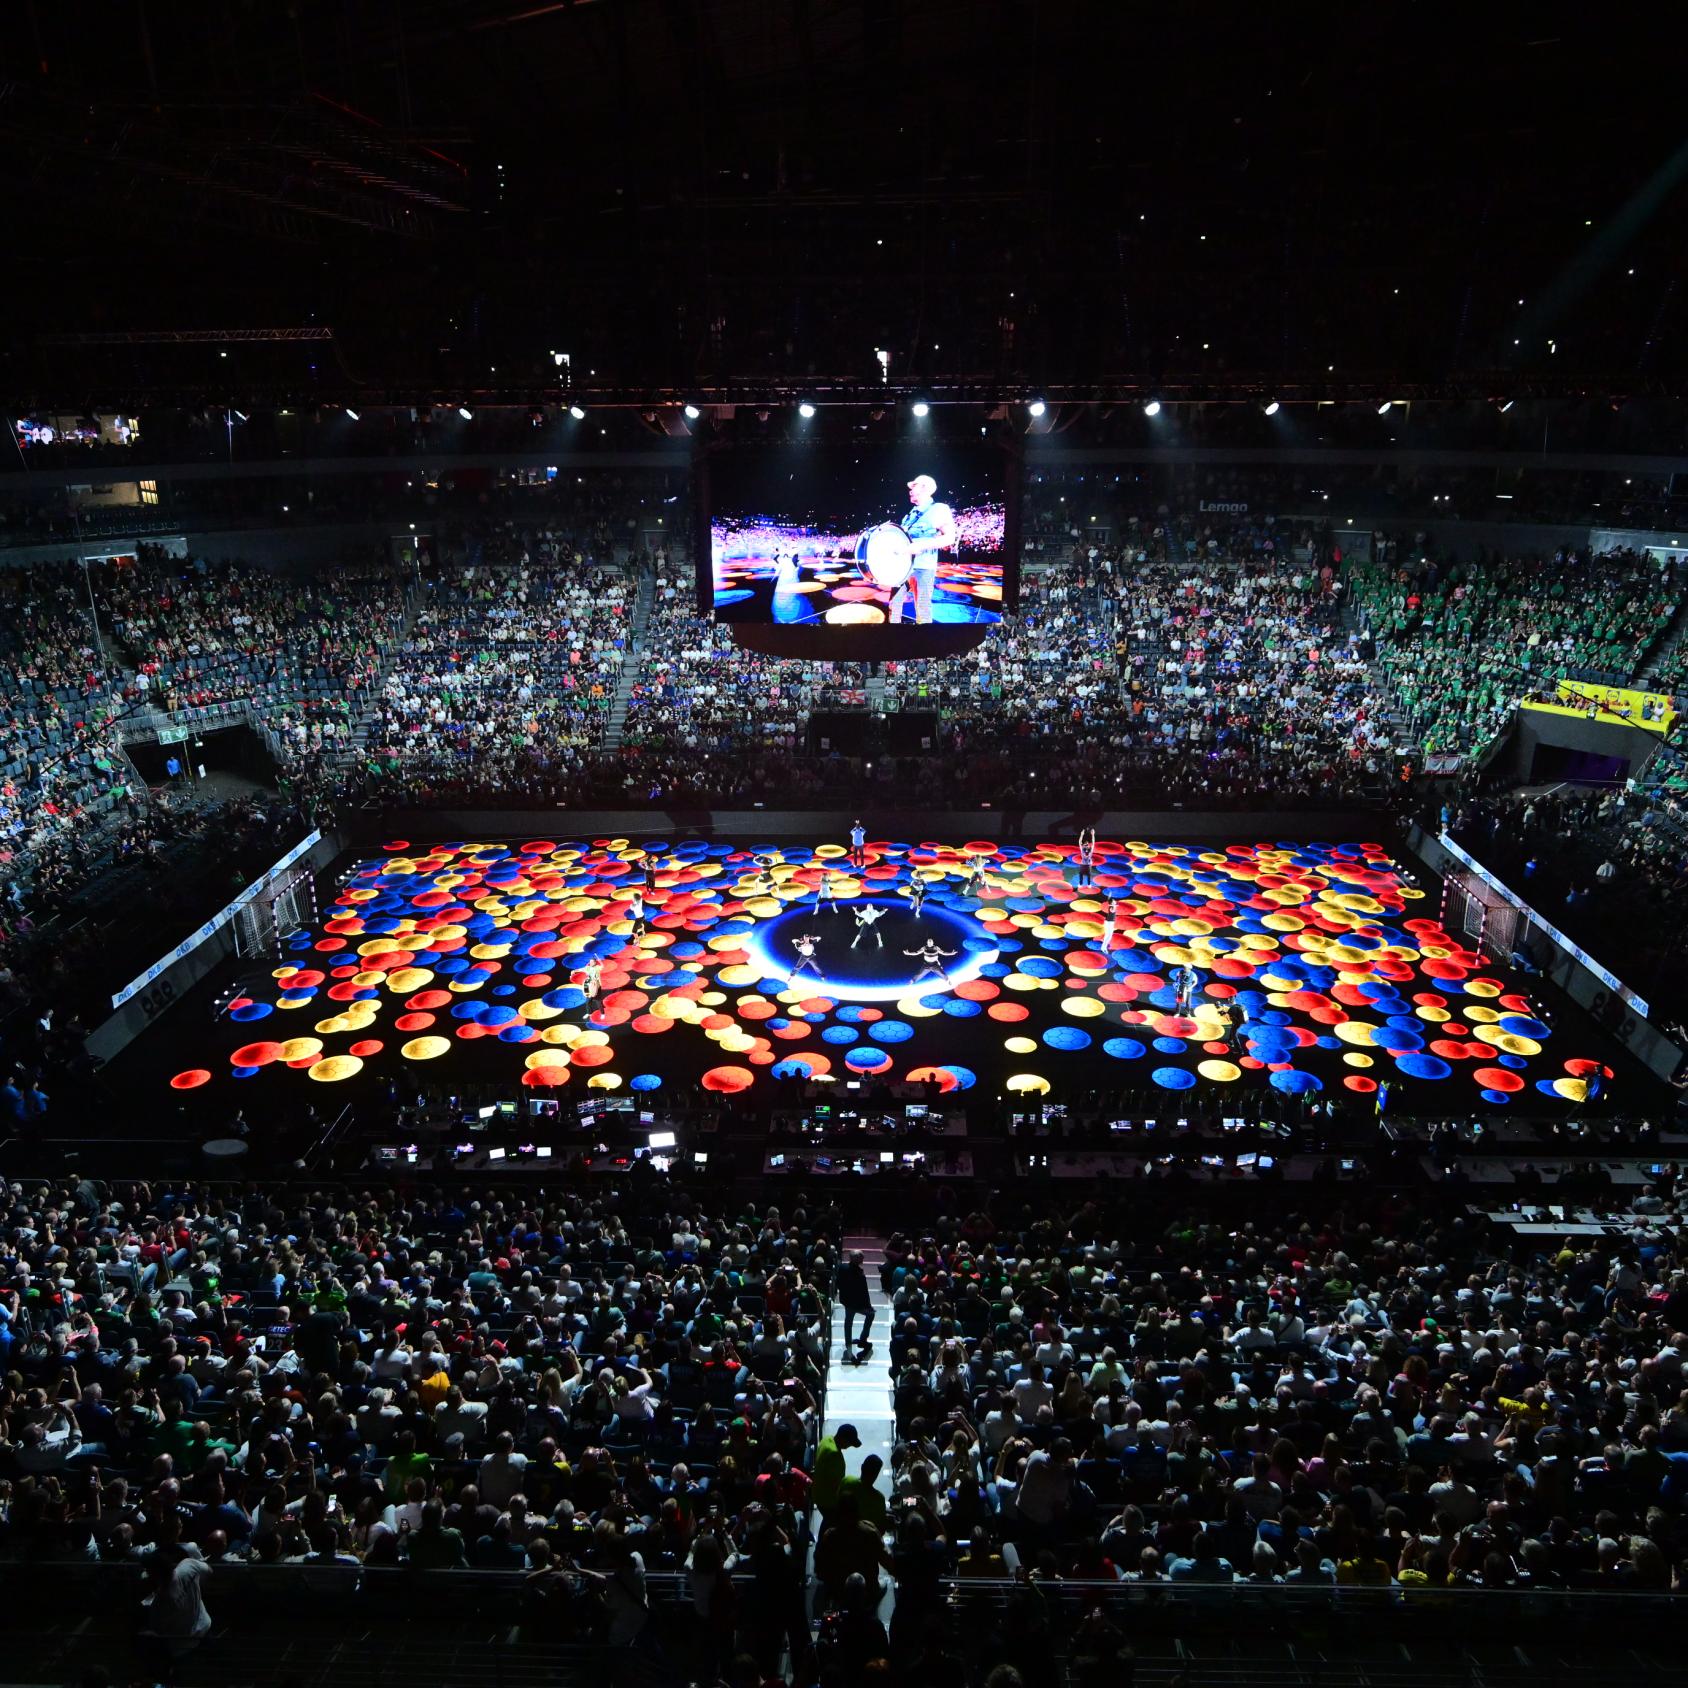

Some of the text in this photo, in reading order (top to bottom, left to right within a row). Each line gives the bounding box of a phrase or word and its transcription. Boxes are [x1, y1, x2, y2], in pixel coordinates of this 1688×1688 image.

[1200, 499, 1248, 516] Lemgo
[176, 942, 190, 958] DKB
[1575, 947, 1588, 965] DKB
[147, 963, 162, 980] DKB
[1602, 971, 1617, 989] DKB
[1631, 995, 1648, 1014] DKB
